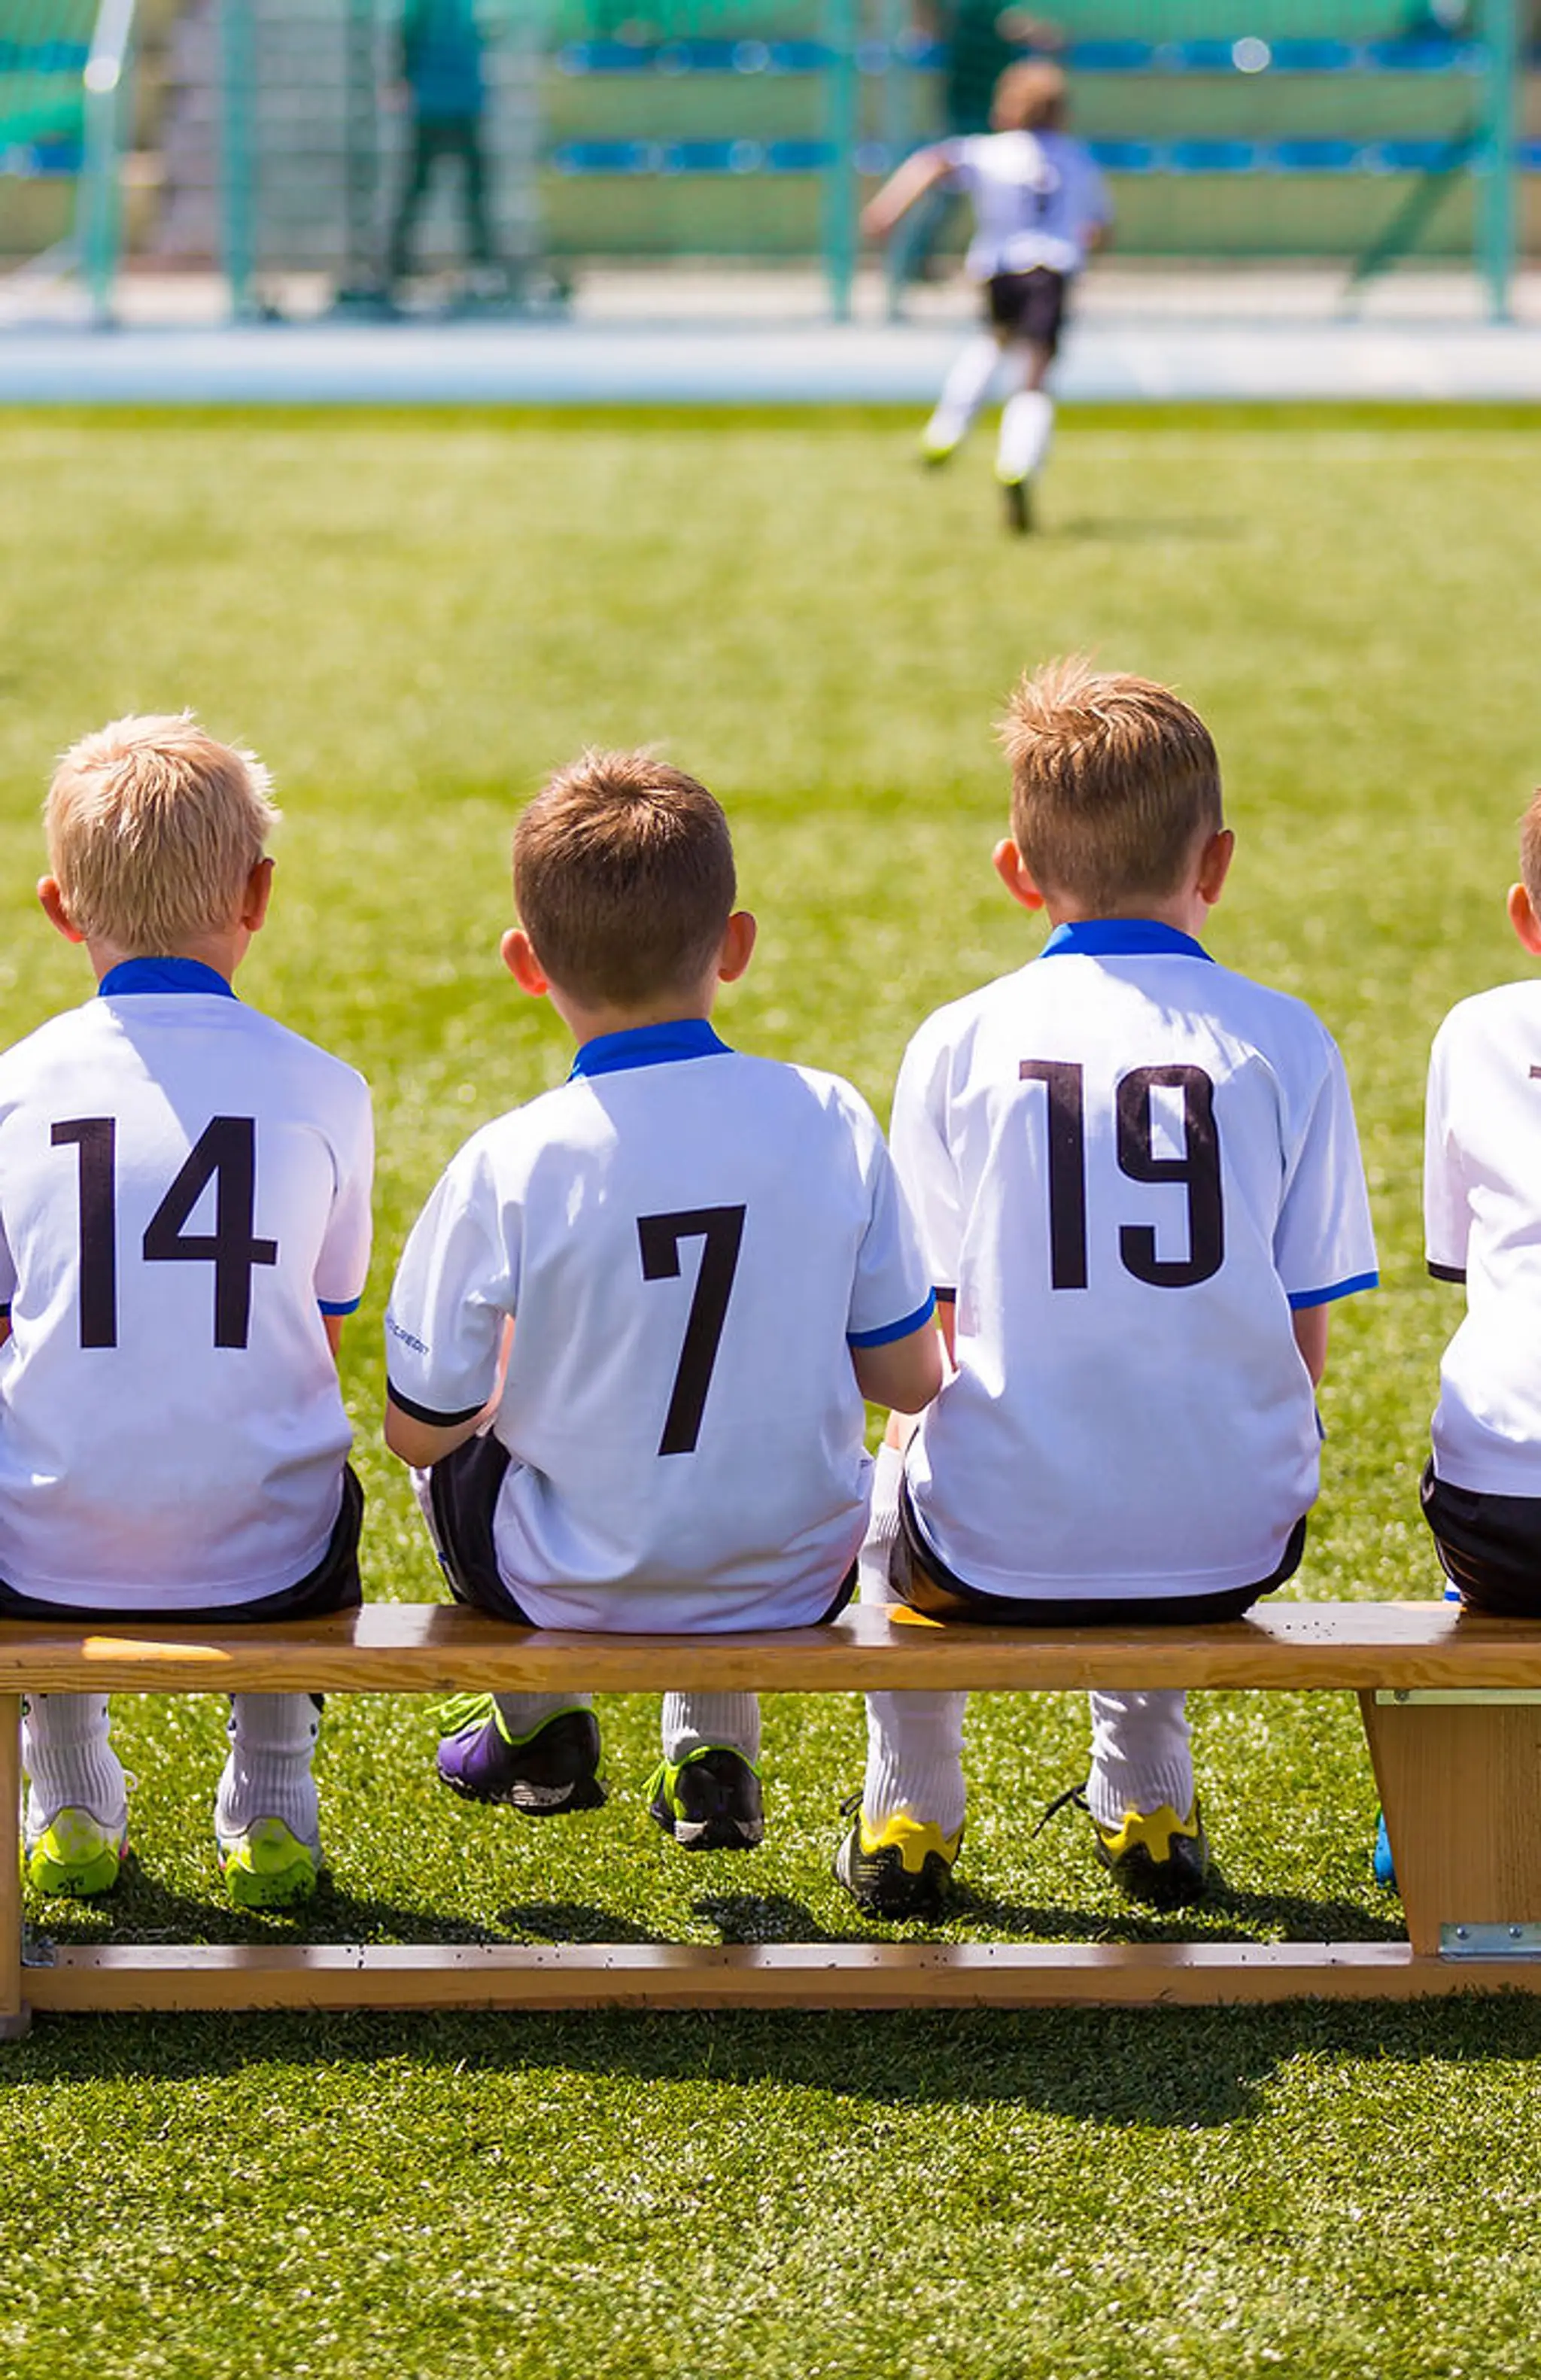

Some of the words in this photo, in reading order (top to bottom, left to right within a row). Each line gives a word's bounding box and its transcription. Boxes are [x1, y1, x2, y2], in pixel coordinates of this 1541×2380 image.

[50, 1117, 278, 1350] 14
[1020, 1060, 1224, 1290] 19
[636, 1204, 747, 1457] 7
